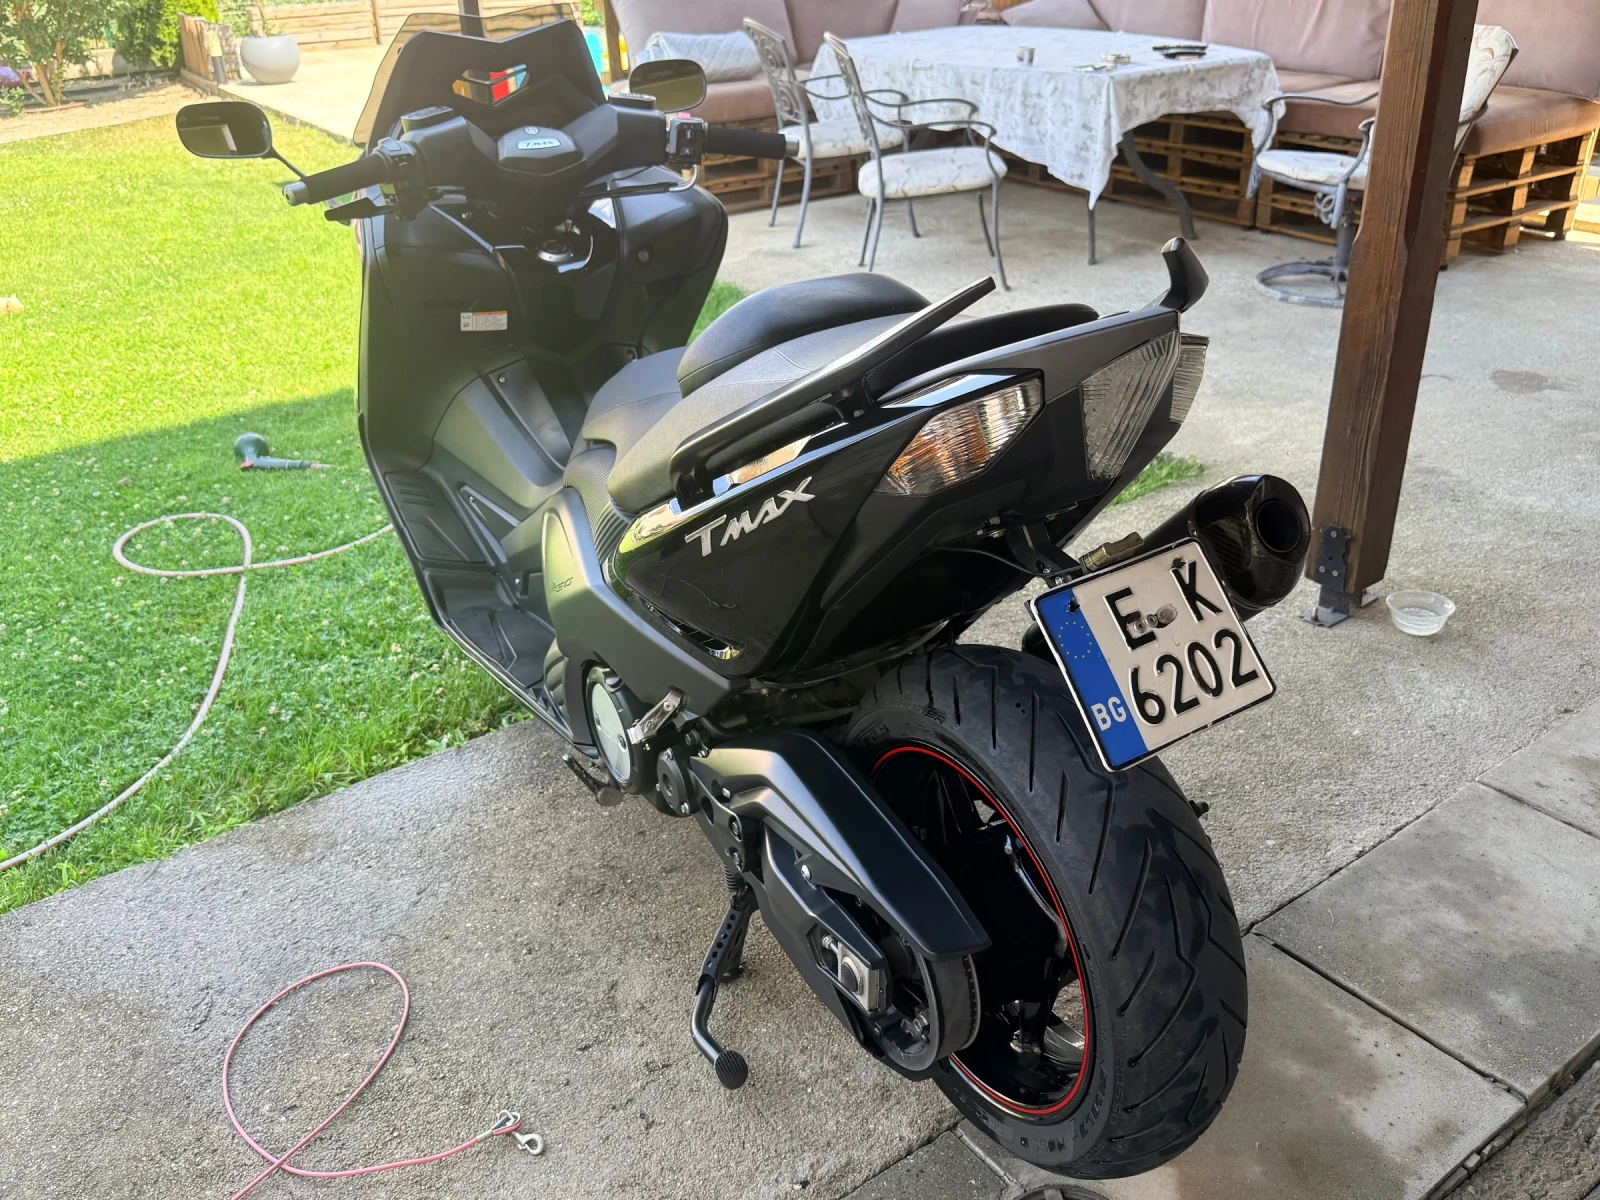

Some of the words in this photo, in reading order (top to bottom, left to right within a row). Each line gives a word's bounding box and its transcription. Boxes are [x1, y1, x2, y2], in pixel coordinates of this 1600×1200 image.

[684, 475, 816, 557] TMAX
[1090, 695, 1127, 732] BG
[1129, 628, 1259, 726] 6202
